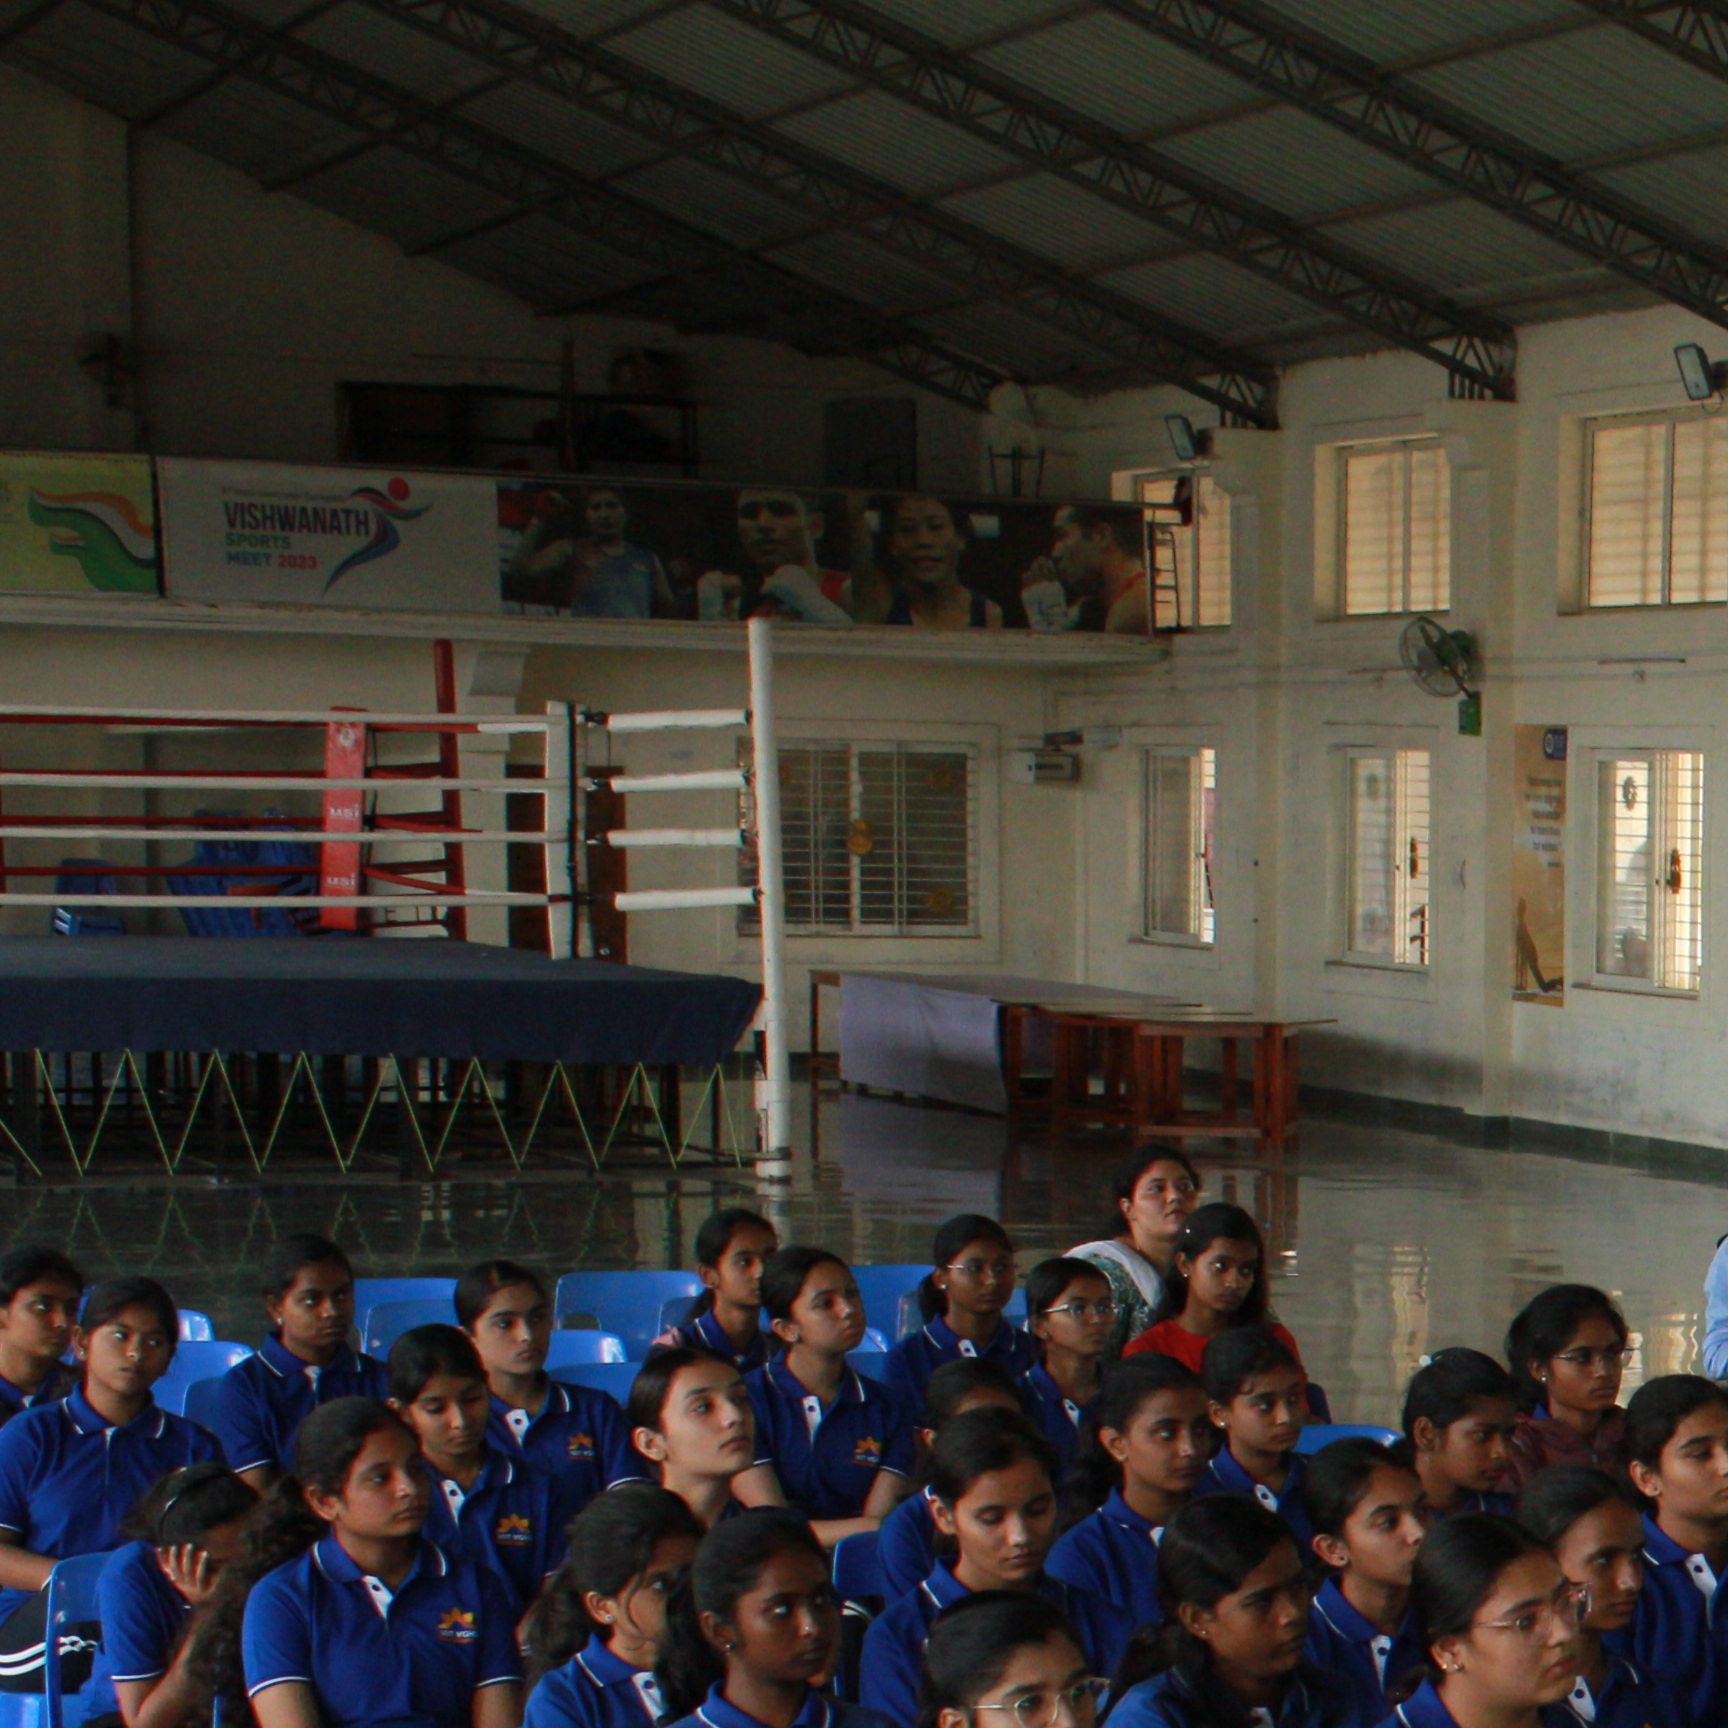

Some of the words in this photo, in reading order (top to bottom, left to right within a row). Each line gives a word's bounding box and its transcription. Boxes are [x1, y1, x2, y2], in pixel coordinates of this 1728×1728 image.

[224, 502, 369, 537] VISHWANATH
[225, 531, 290, 549] SPORTS
[226, 551, 272, 566] MEET
[278, 554, 318, 569] 2023
